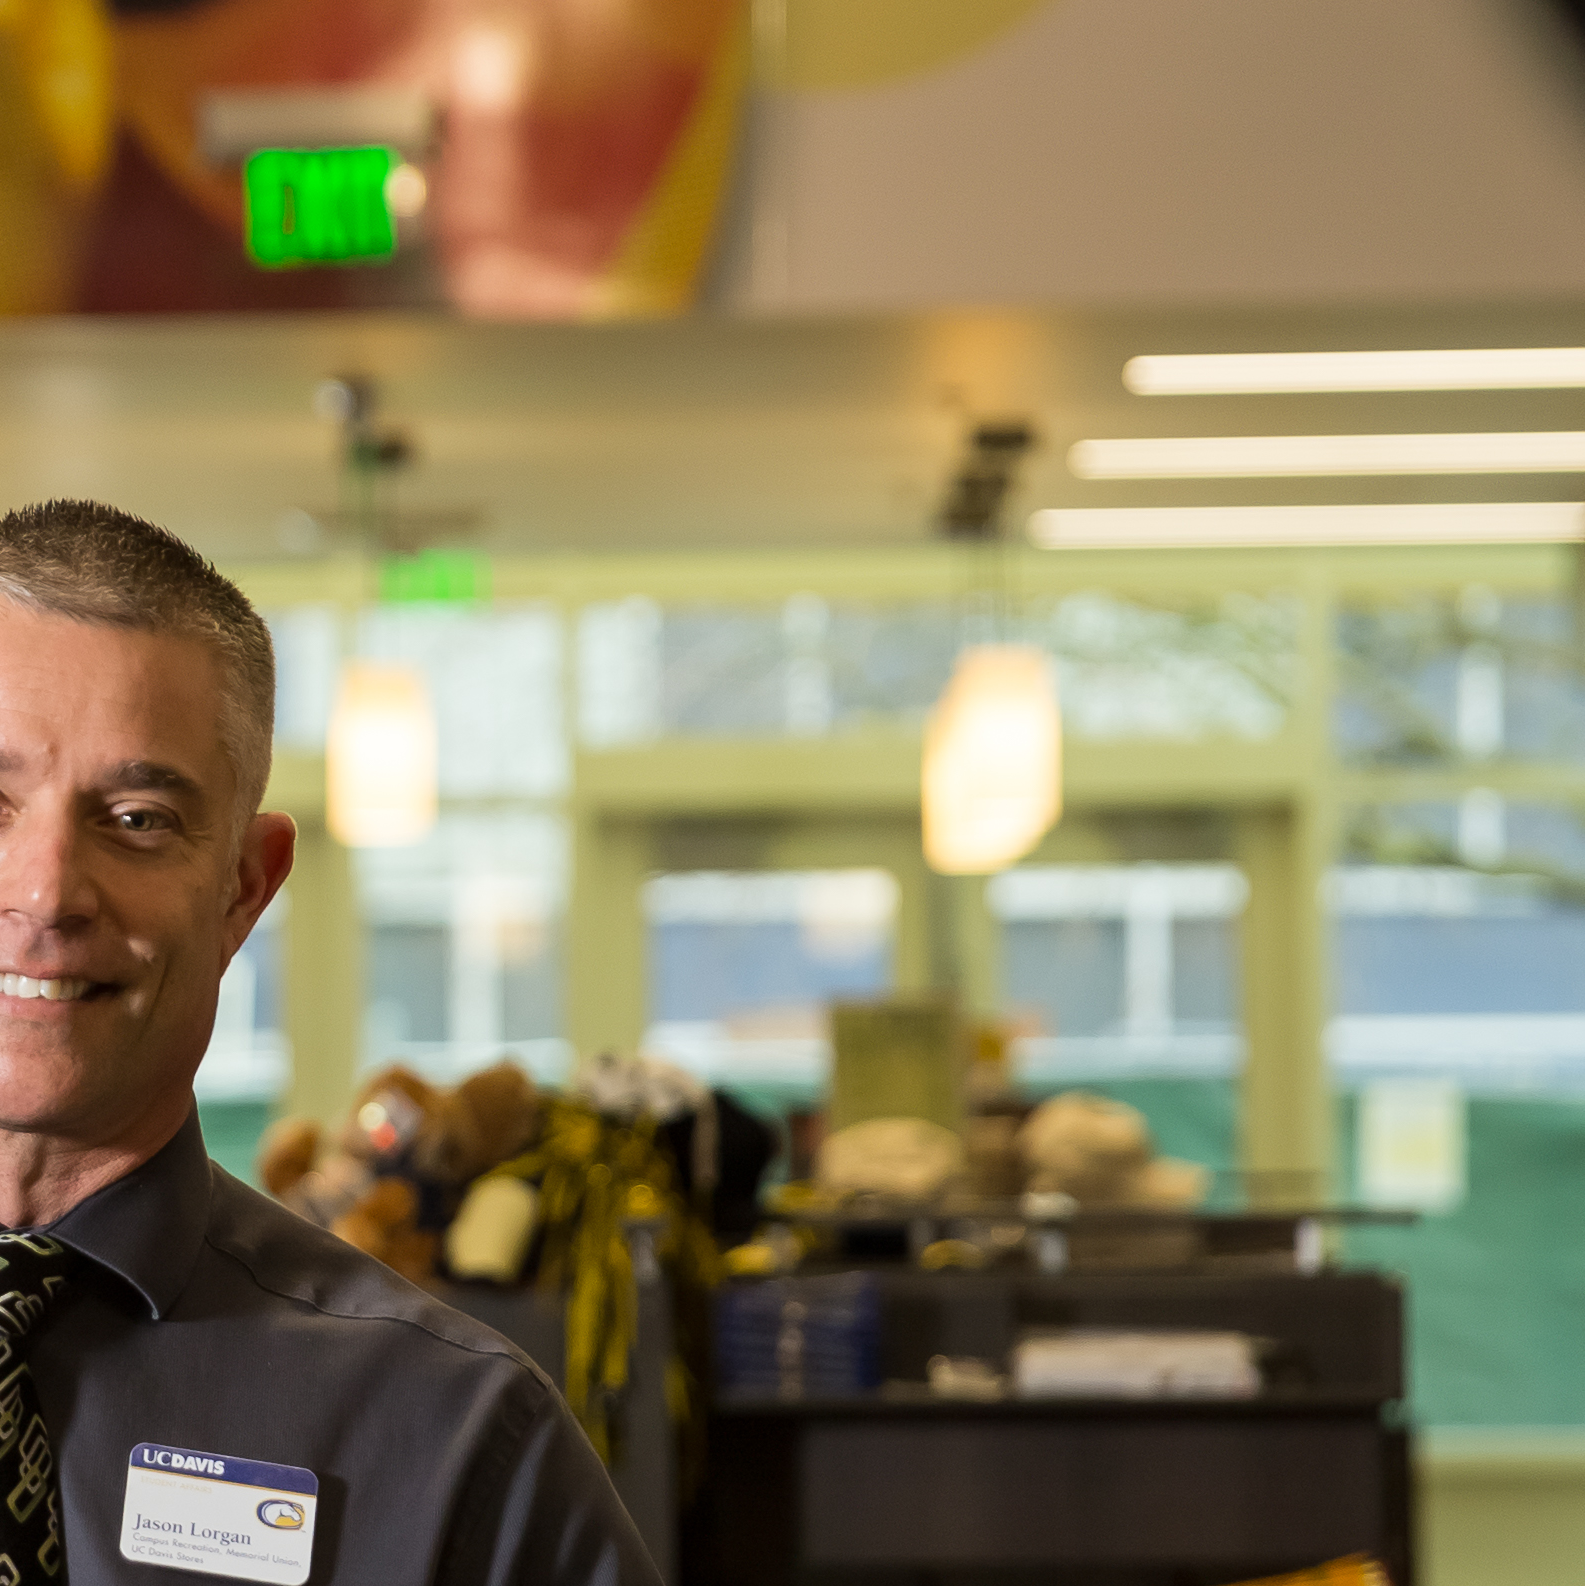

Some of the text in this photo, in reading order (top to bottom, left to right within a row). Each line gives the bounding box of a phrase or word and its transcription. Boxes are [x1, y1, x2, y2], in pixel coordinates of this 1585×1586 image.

[132, 1513, 251, 1546] Jason Lorgan
[131, 1545, 204, 1564] UC Davis Stores
[133, 1532, 169, 1546] Campus
[225, 1548, 269, 1561] Memorial
